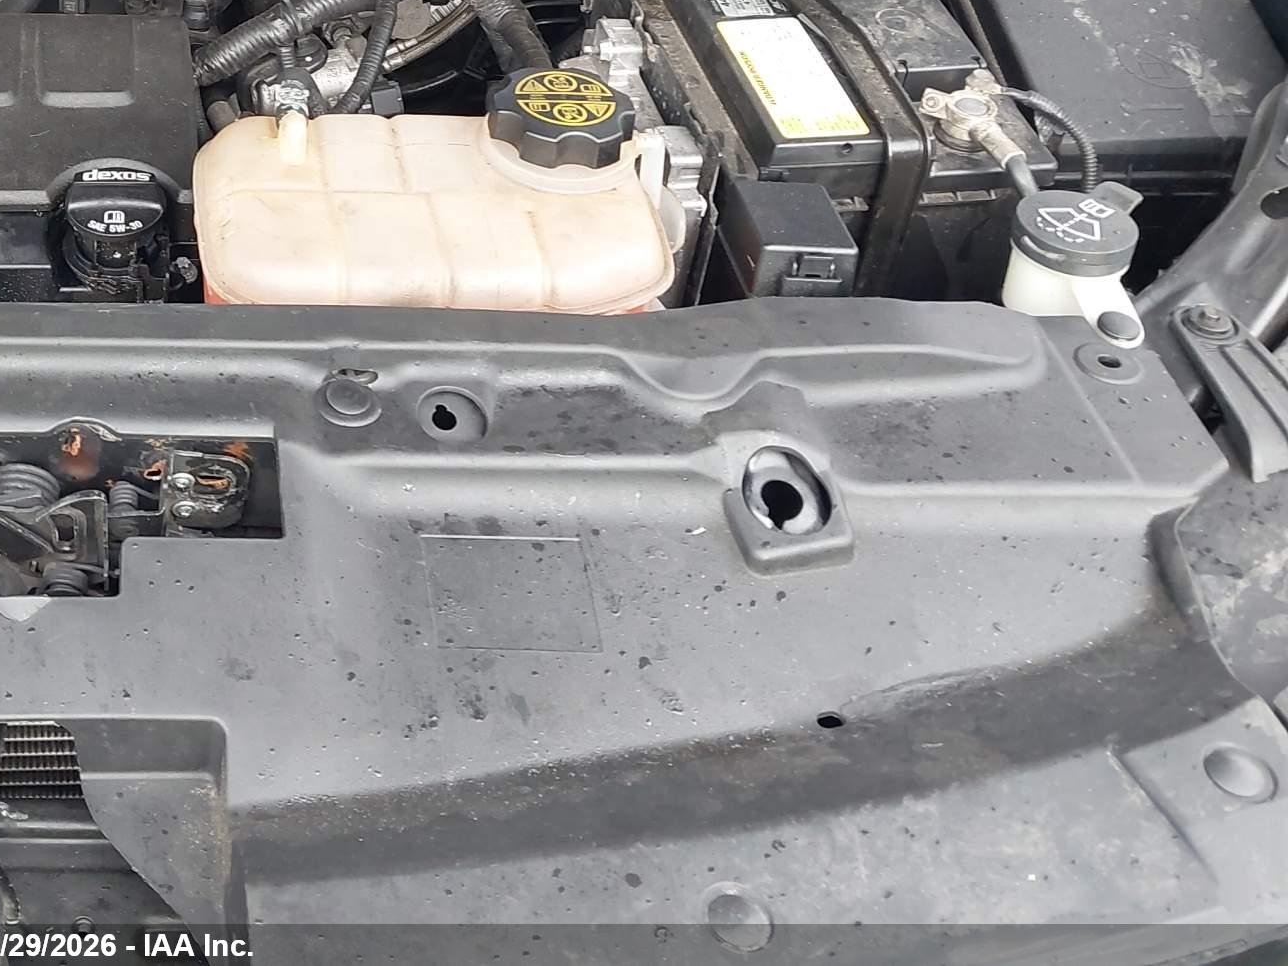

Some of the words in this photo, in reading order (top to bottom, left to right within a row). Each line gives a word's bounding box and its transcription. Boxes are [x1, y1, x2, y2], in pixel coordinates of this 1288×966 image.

[82, 168, 152, 182] dexos
[87, 219, 108, 233] SAE
[108, 220, 144, 233] 5W-30
